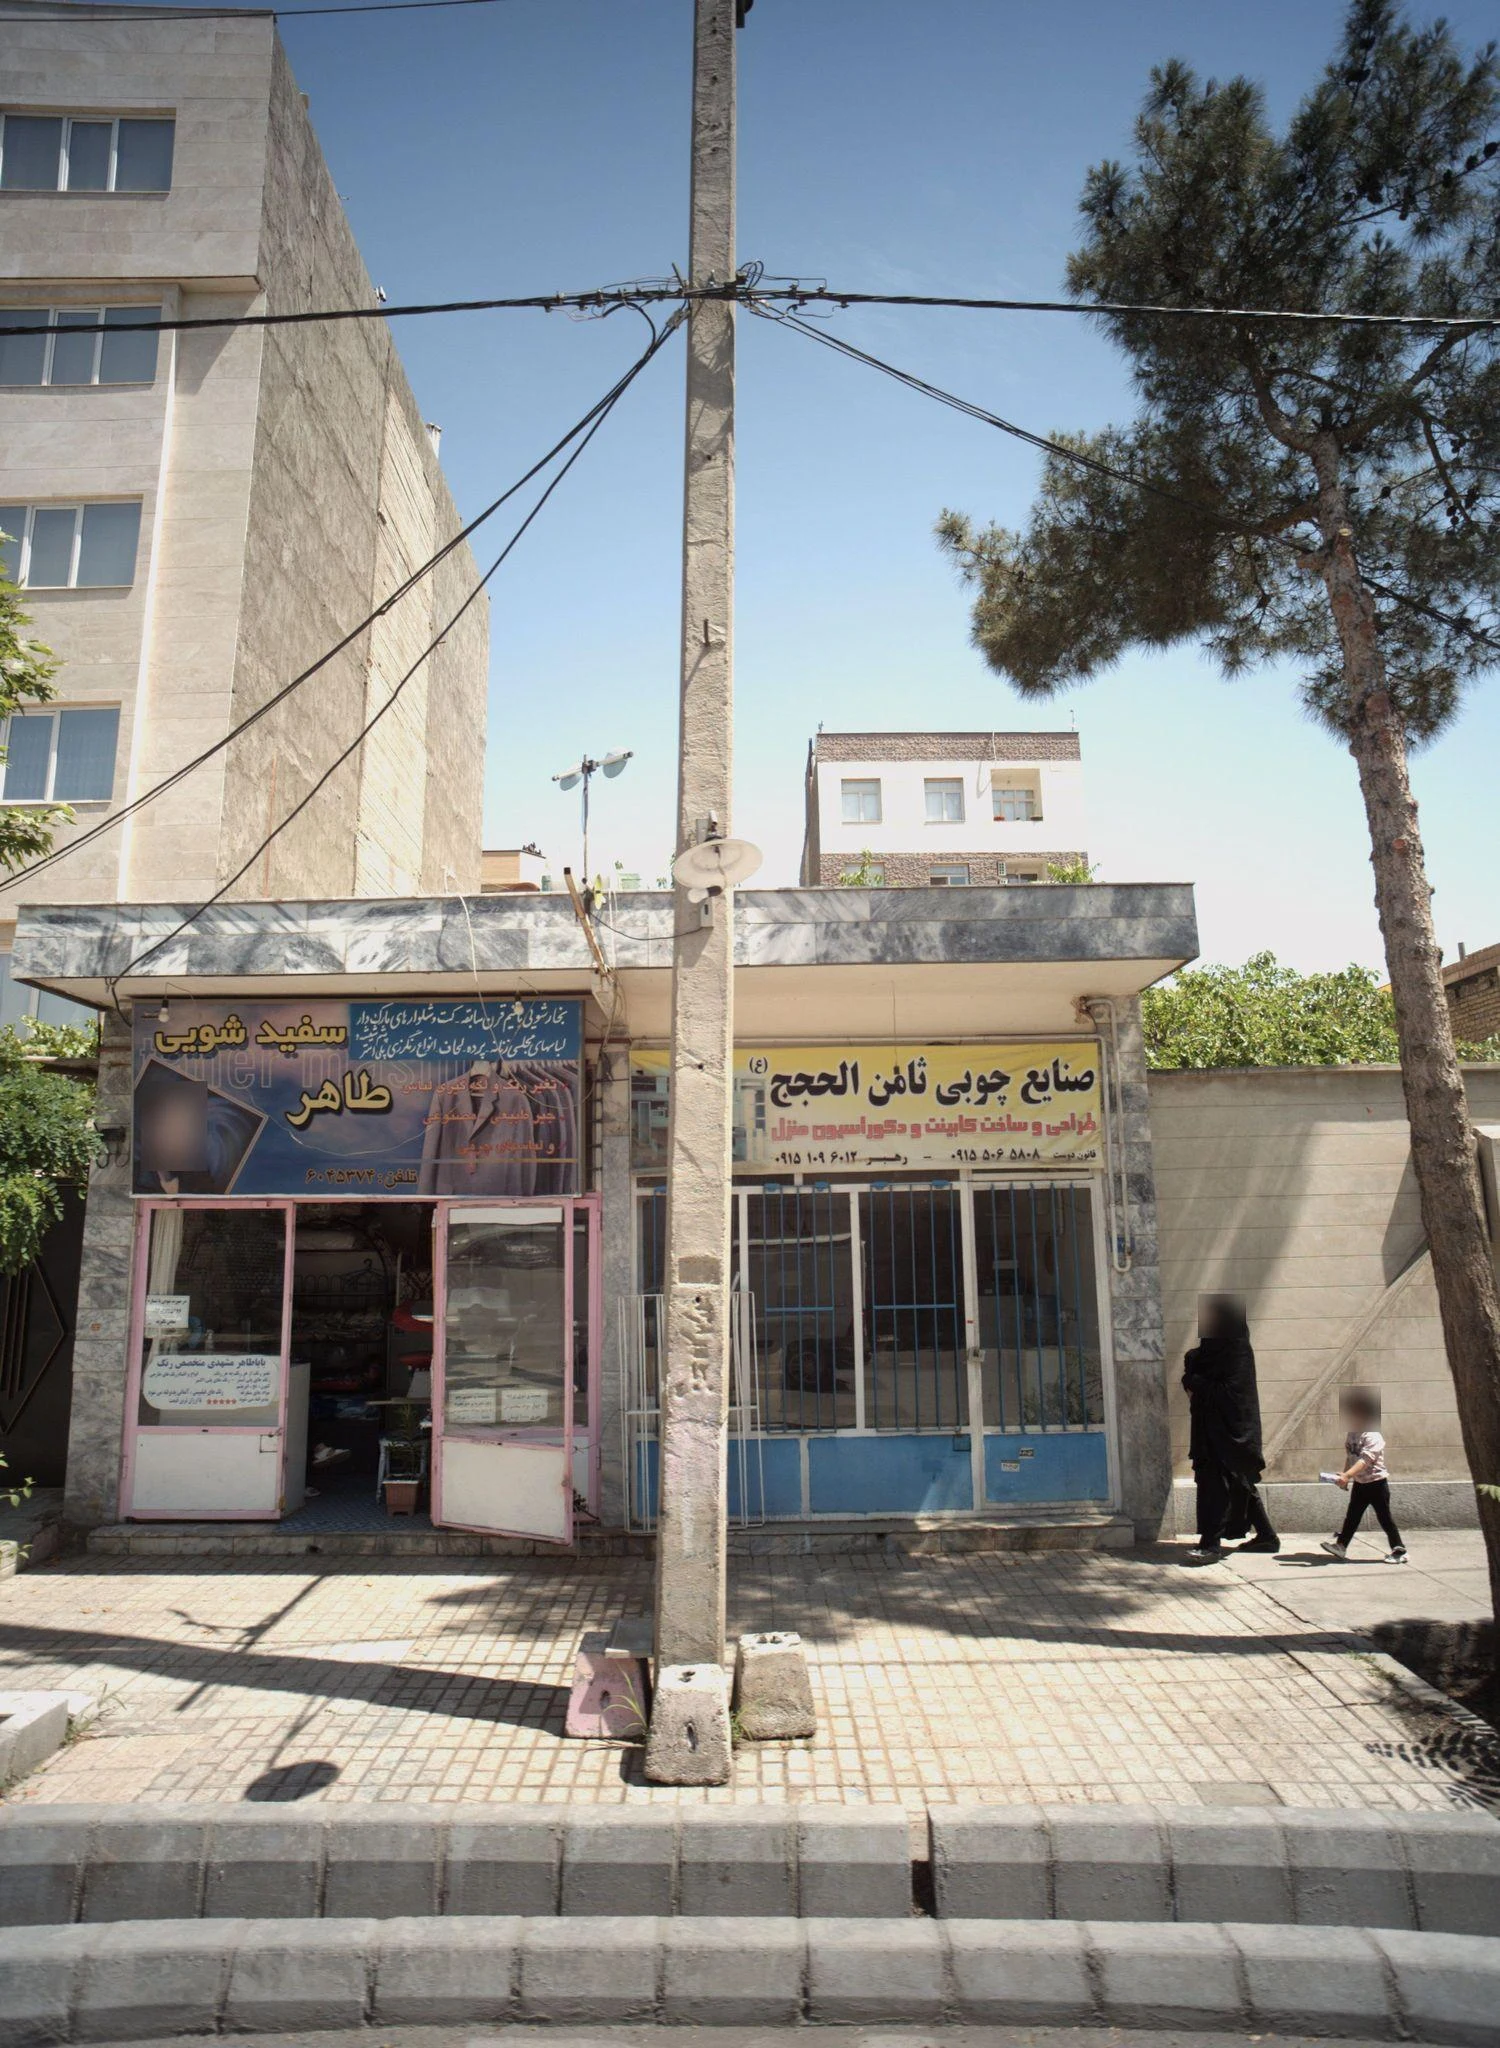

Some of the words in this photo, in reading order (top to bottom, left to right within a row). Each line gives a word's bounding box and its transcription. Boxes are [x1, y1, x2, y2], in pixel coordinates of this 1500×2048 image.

[438, 1004, 464, 1024] کت
[461, 1008, 484, 1029] سابقه
[481, 1003, 507, 1030] قرن
[154, 1013, 248, 1054] شویی
[254, 1015, 347, 1054] سفید
[416, 1036, 437, 1058] انواع
[438, 1037, 465, 1055] لحاف
[466, 1041, 487, 1060] پرده
[748, 1056, 769, 1075] (ع)
[401, 1079, 433, 1096] لباس
[468, 1078, 488, 1091] لکه
[770, 1060, 860, 1108] الحجج
[868, 1056, 927, 1107] ثامن
[936, 1066, 1012, 1106] چوبی
[1020, 1057, 1096, 1105] صنایع
[284, 1069, 394, 1129] طاهر
[422, 1110, 477, 1127] مصنوعی
[489, 1109, 530, 1126] طبیعی
[532, 1113, 556, 1126] جیر
[925, 1114, 978, 1138] کابینت
[980, 1113, 1029, 1133] ساخت
[1045, 1112, 1097, 1137] طراحی
[771, 1117, 810, 1142] منزل
[812, 1115, 908, 1141] دکوراسیون
[910, 1123, 922, 1140] و
[1031, 1120, 1043, 1137] و
[547, 1142, 555, 1155] و
[1052, 1151, 1076, 1160] دوست
